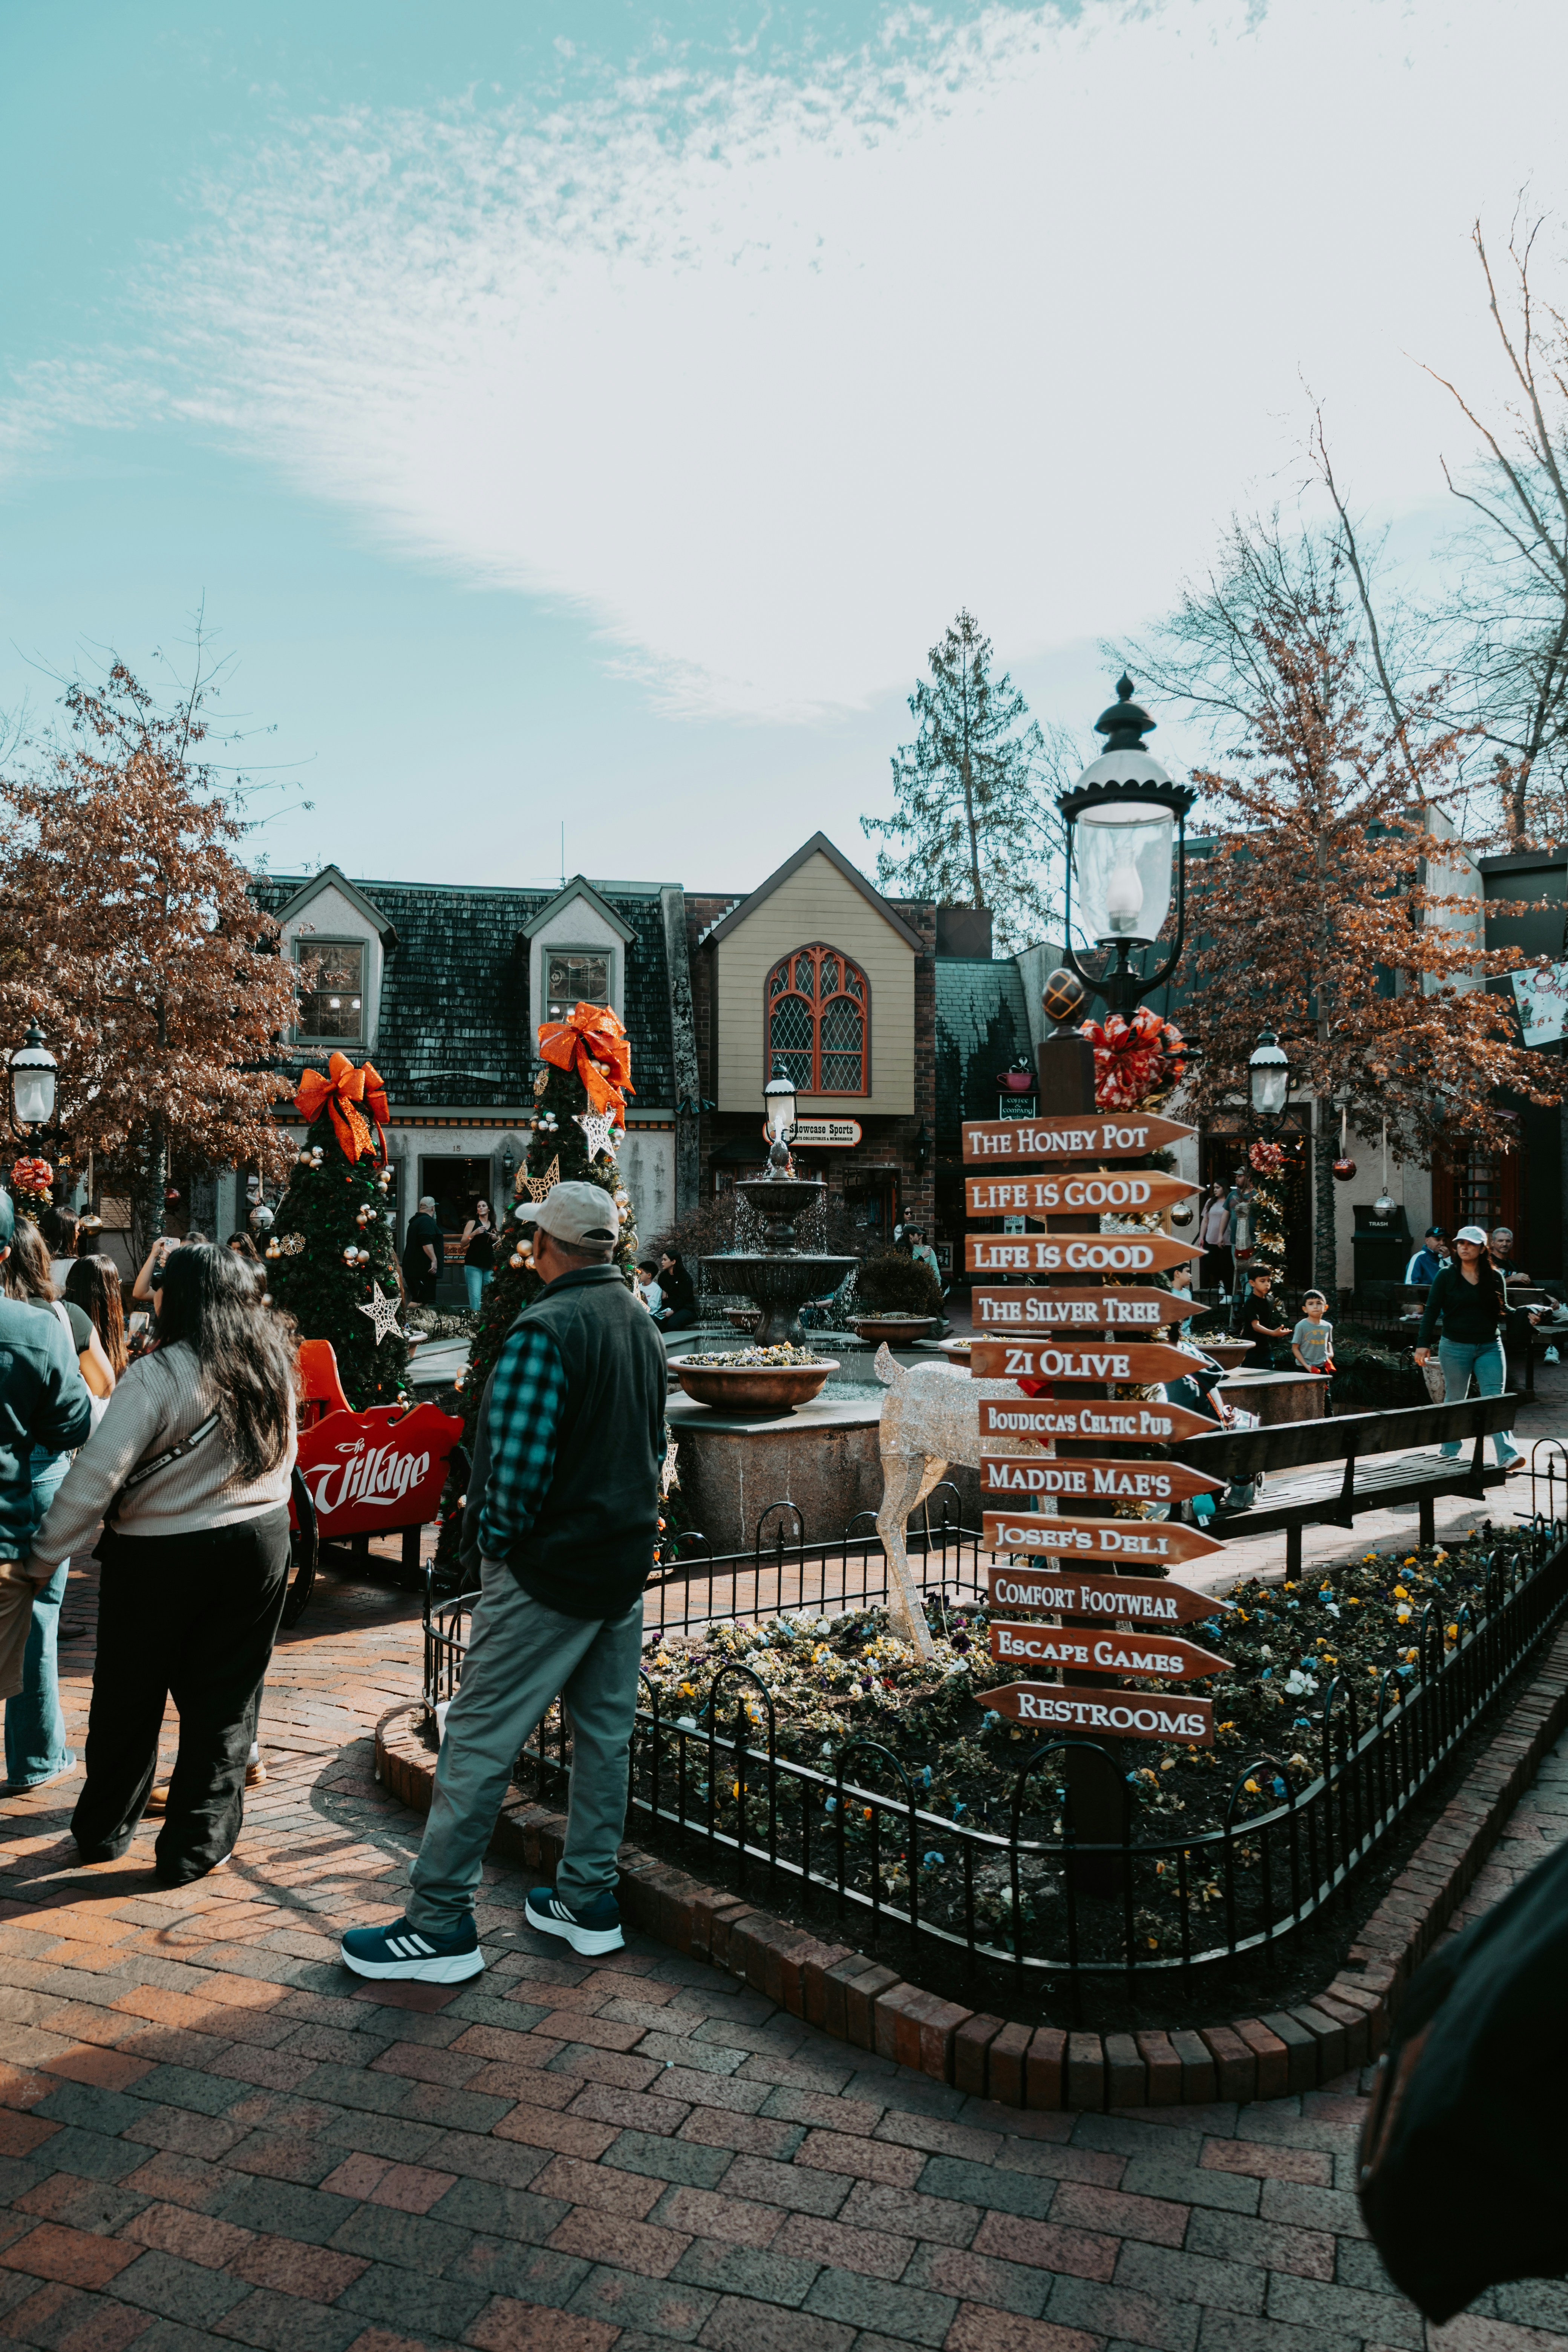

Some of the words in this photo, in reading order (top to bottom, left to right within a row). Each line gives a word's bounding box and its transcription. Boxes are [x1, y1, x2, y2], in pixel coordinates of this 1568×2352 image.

[829, 1124, 853, 1136] Sports
[969, 1132, 1011, 1154] THE
[1017, 1129, 1097, 1152] HONEY
[1102, 1125, 1148, 1148] POT
[972, 1185, 1028, 1208] LIFE
[1035, 1184, 1059, 1206] IS
[1064, 1181, 1151, 1205] GOOD
[974, 1244, 1029, 1268] LIFE
[1035, 1243, 1061, 1268] IS
[1066, 1242, 1153, 1269] GOOD
[979, 1298, 1022, 1321] THE
[1026, 1298, 1099, 1321] SILVER
[1103, 1298, 1160, 1322] TREE
[1005, 1349, 1034, 1374] ZI
[1040, 1350, 1130, 1377] OLIVE
[988, 1407, 1076, 1432] BOUDICCA'S
[1080, 1409, 1136, 1434] CELTIC
[1139, 1411, 1172, 1435] PUB
[335, 1438, 365, 1454] The
[136, 1470, 147, 1478] kate
[147, 1461, 161, 1472] spade
[302, 1441, 430, 1514] Village
[988, 1464, 1086, 1492] MADDIE
[1093, 1468, 1171, 1496] MAE'S
[995, 1523, 1093, 1548] JOSEF'S
[1099, 1530, 1169, 1554] DELI
[995, 1579, 1075, 1608] COMFORT
[1081, 1586, 1178, 1619] FOOTWEAR
[998, 1631, 1088, 1662] ESCAPE
[1094, 1642, 1184, 1673] GAMES
[1018, 1692, 1206, 1735] RESTROOMS
